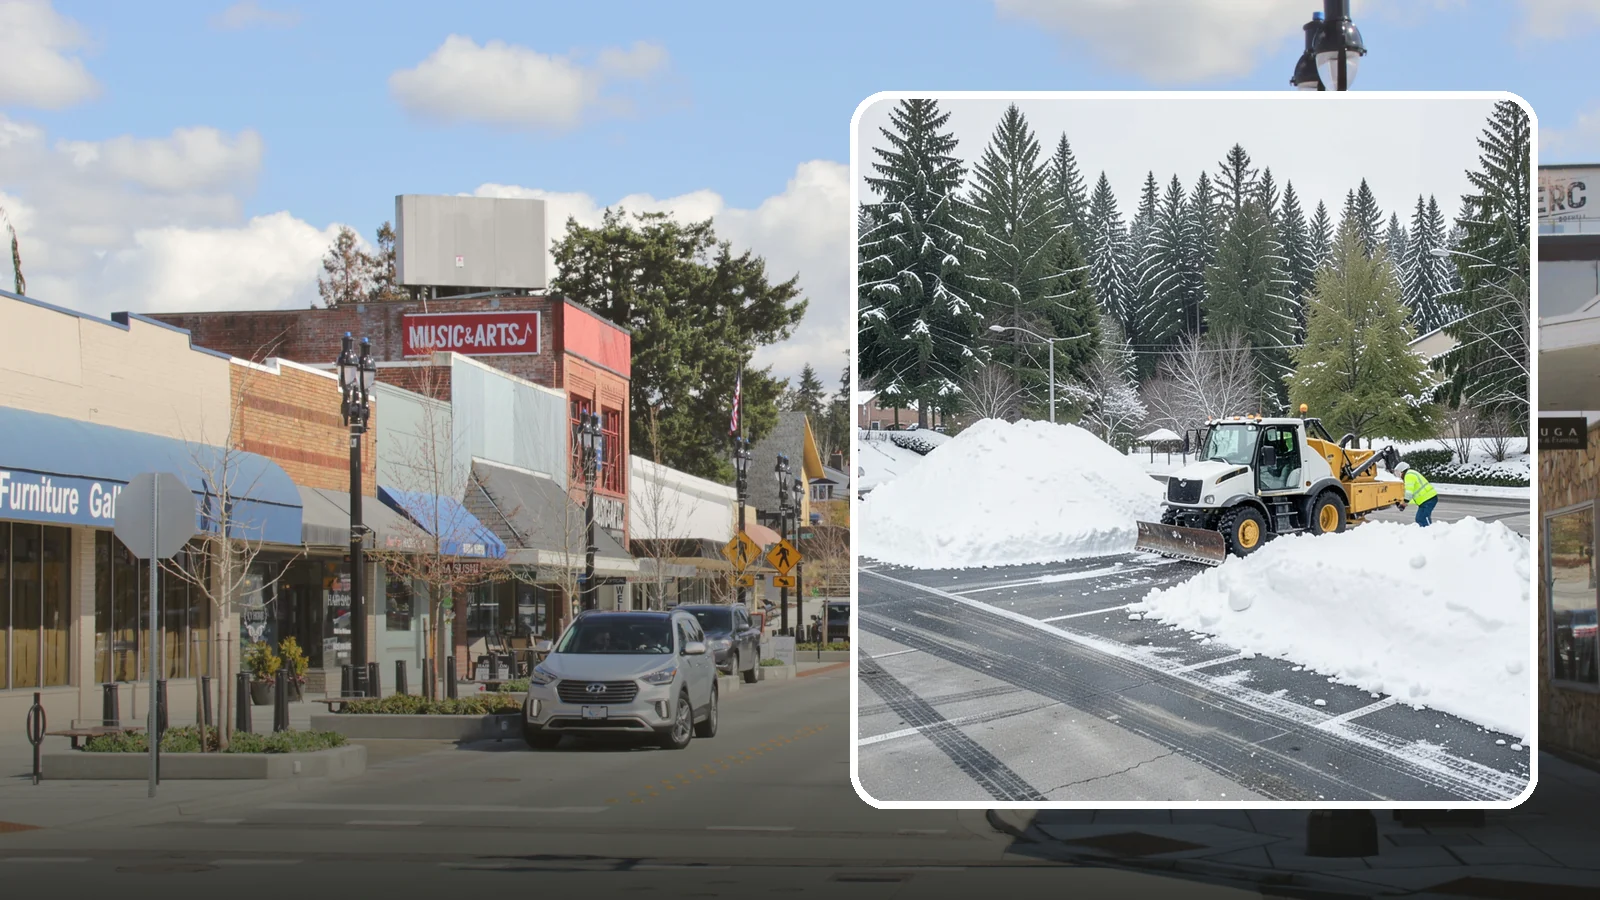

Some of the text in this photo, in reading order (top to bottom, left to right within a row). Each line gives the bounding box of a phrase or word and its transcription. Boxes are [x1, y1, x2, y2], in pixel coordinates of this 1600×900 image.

[409, 323, 519, 349] MUSIC&ARTS
[1540, 427, 1577, 436] UGA
[0, 471, 79, 515] Furniture
[453, 563, 479, 574] SUSHI
